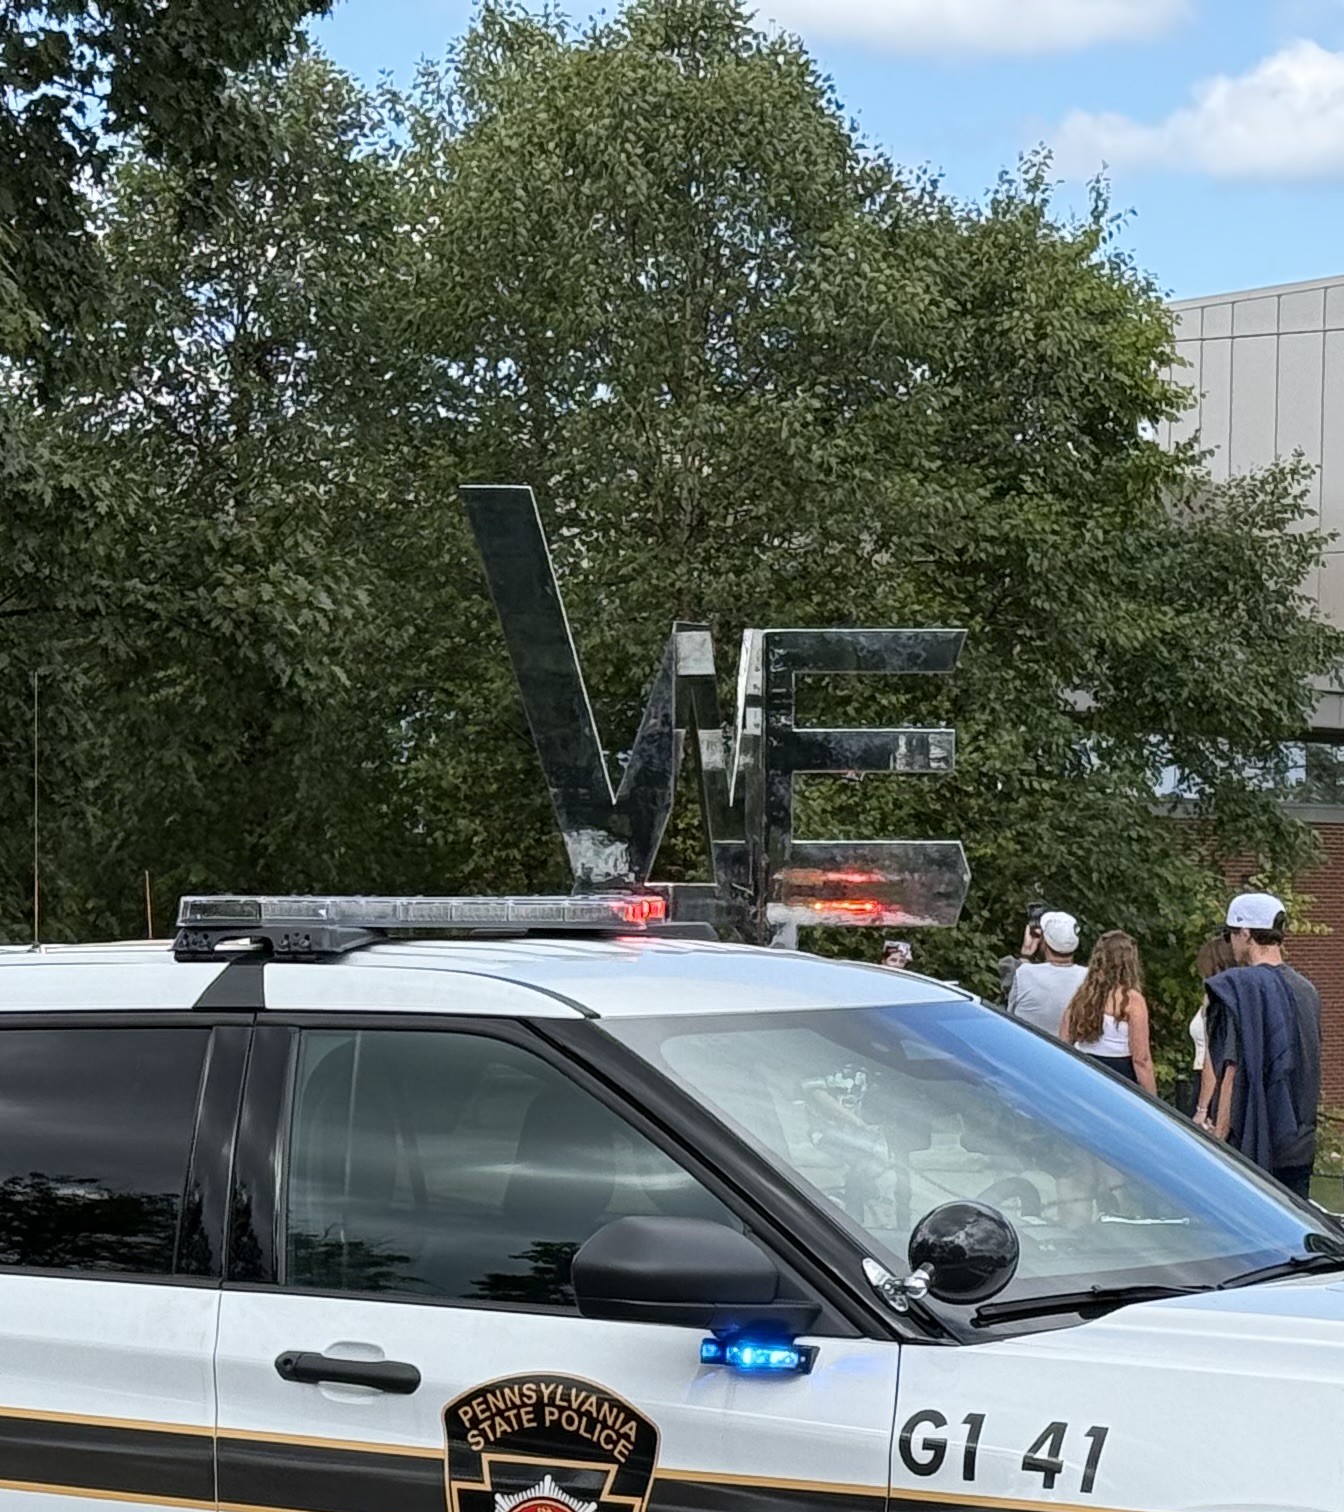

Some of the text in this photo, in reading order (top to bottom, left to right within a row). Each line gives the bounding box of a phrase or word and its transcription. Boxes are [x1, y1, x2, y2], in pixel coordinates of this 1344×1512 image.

[458, 1382, 637, 1442] PENNSYLVANIA
[467, 1407, 634, 1463] STATE POLICE
[899, 1409, 1109, 1494] G1 41
